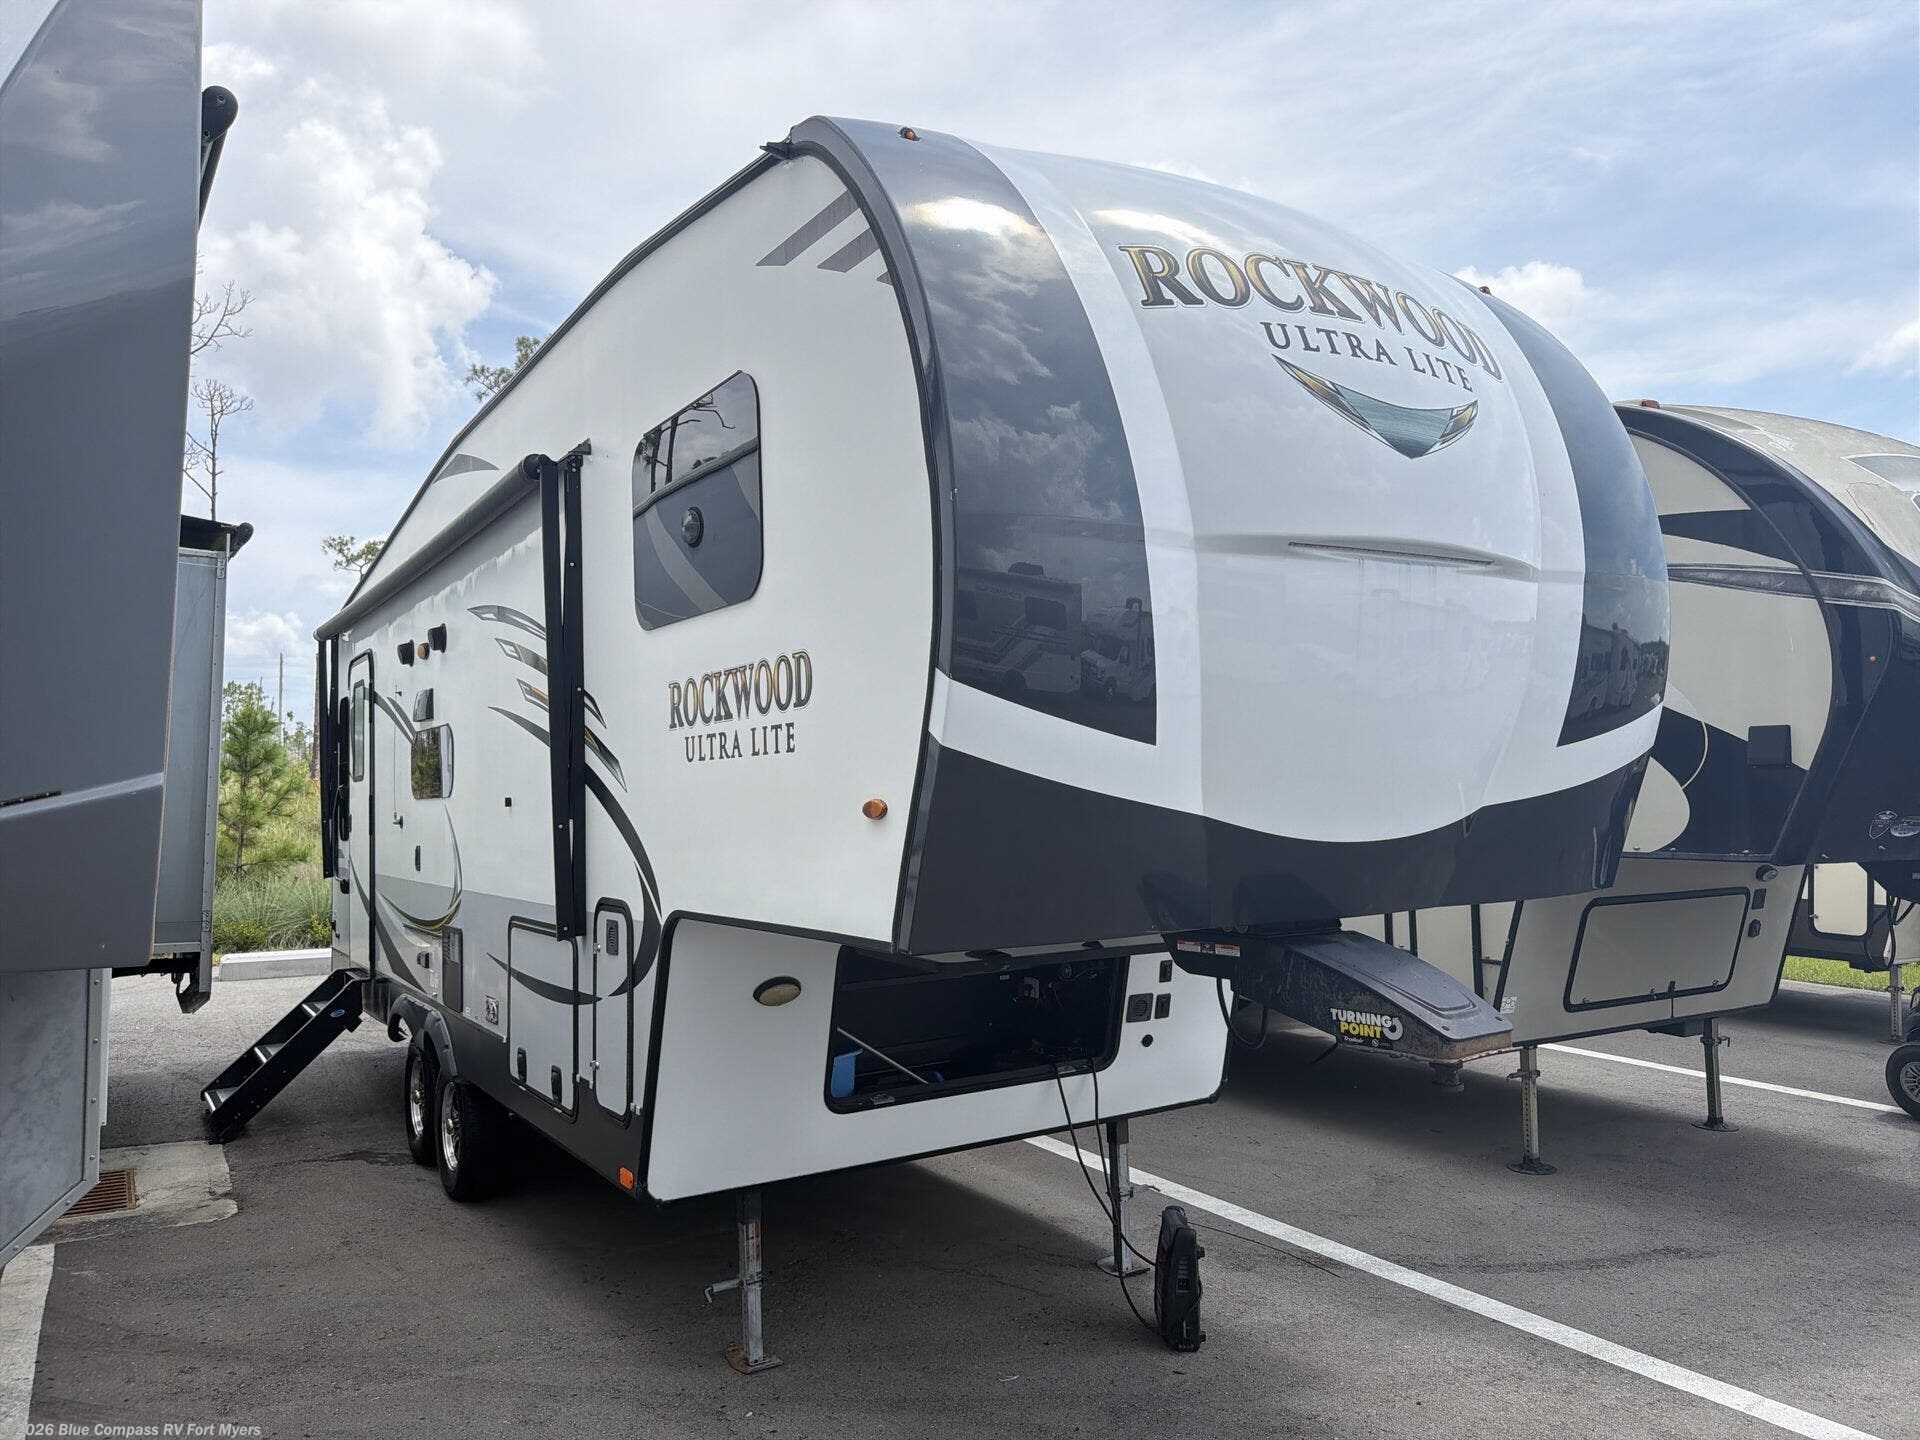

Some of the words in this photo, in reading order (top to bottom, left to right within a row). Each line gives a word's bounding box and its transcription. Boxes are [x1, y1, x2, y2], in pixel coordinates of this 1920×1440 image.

[1118, 245, 1502, 380] ROCKWOOD
[1260, 321, 1397, 366] ULTRA
[1405, 346, 1473, 392] LITE
[668, 650, 813, 729] ROCKWOOD
[685, 730, 743, 762] ULTRA
[751, 722, 796, 756] LITE
[1330, 1008, 1392, 1028] TURNING
[1340, 1022, 1382, 1039] POINT
